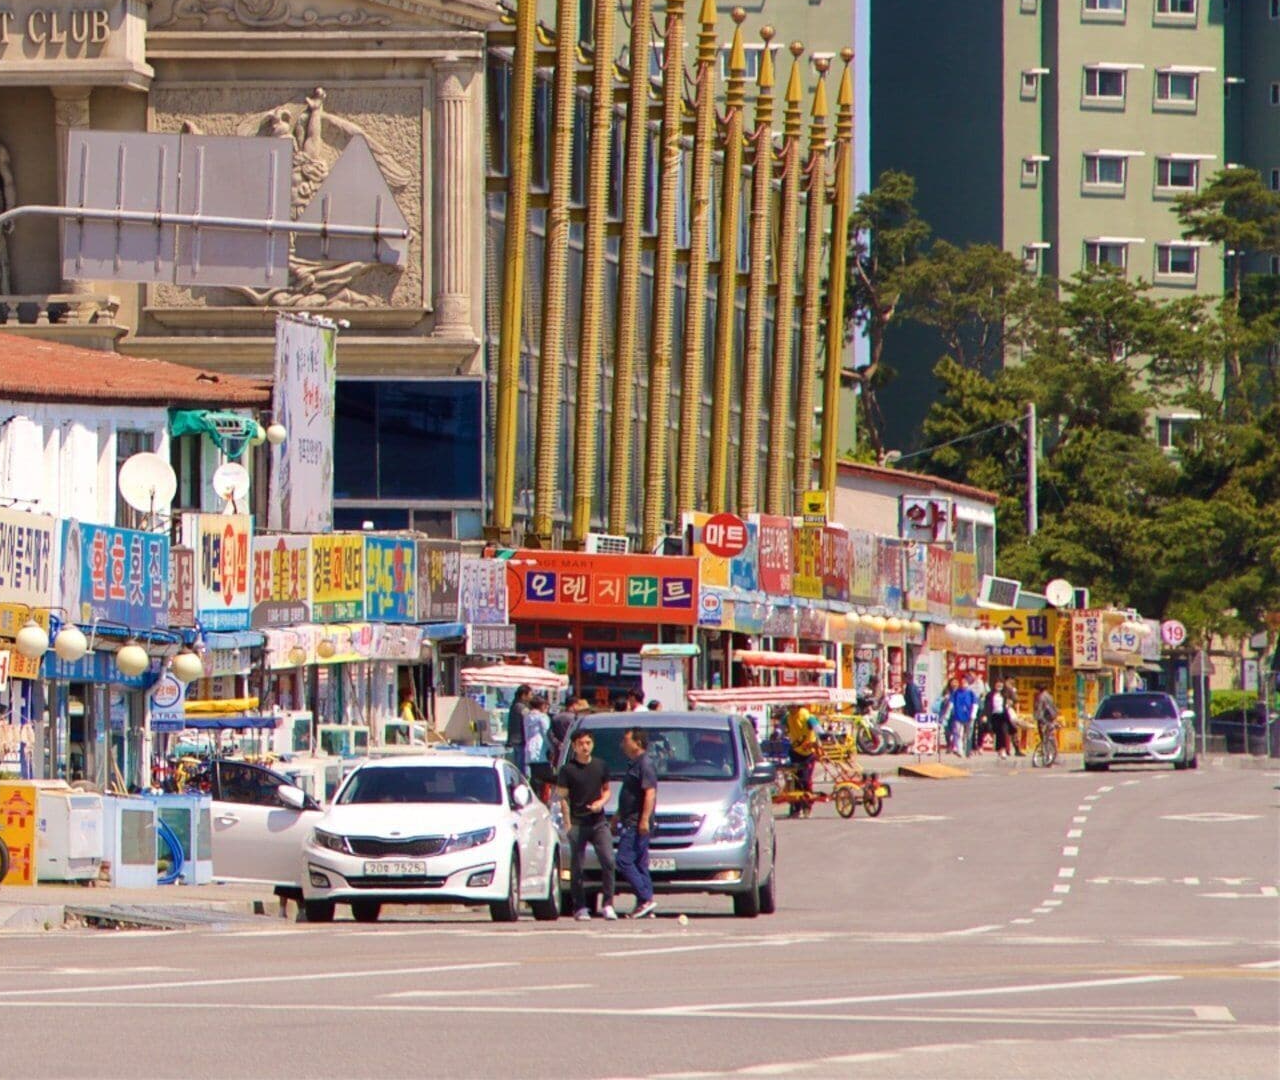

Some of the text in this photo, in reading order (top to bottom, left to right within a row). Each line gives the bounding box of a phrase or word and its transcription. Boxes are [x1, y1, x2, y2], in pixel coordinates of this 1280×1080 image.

[27, 9, 112, 45] CLUB
[705, 524, 744, 549] 마트
[531, 573, 691, 606] 오렌지마트
[1168, 625, 1184, 642] 19
